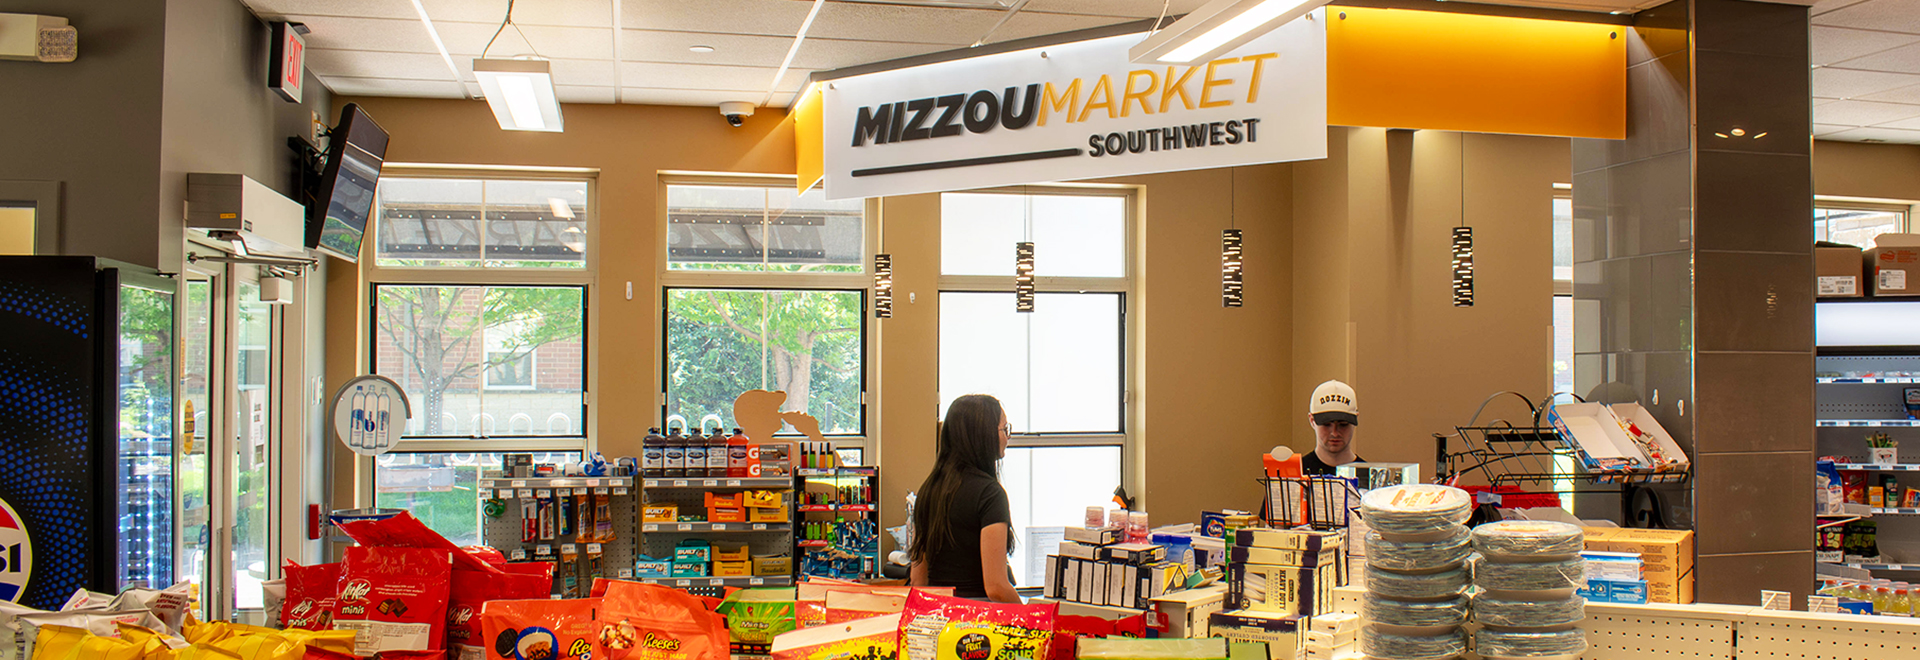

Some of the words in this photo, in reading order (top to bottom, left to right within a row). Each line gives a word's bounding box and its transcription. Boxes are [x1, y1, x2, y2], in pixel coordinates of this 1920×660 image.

[286, 34, 302, 89] EXIT
[1088, 118, 1260, 158] SOUTHWEST
[748, 447, 759, 460] G
[749, 463, 761, 476] G
[341, 604, 365, 615] minis
[641, 631, 681, 651] Reese's
